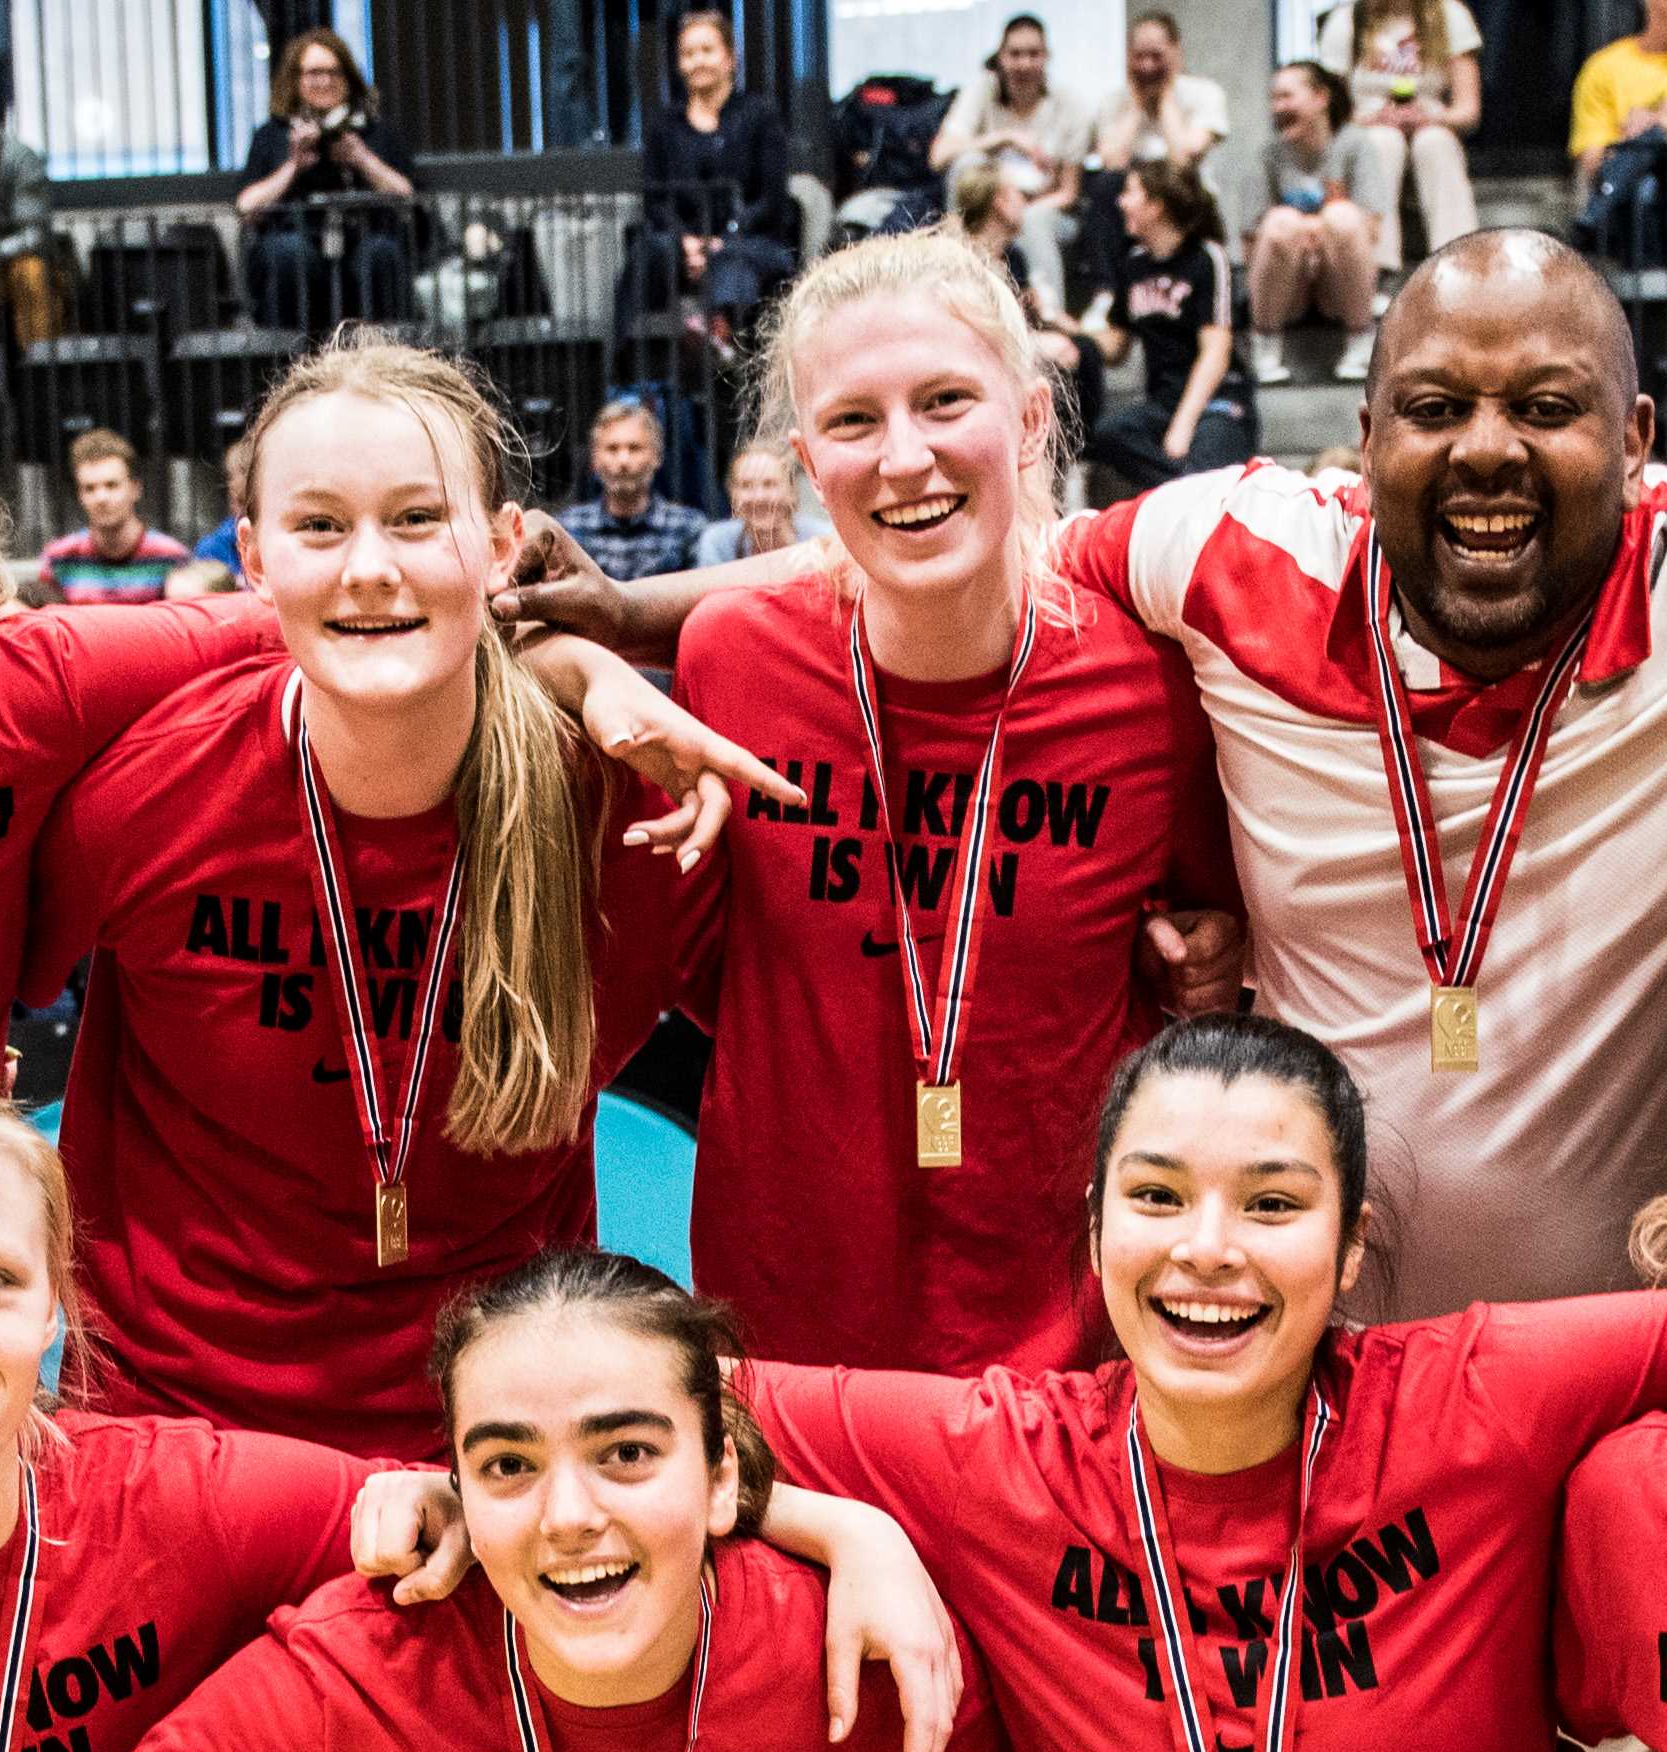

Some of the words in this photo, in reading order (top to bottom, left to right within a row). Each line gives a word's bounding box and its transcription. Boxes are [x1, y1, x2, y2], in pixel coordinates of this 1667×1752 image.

[809, 836, 862, 902] IS
[883, 840, 1019, 917] WN
[185, 894, 289, 964] ALL
[259, 973, 314, 1031] IS
